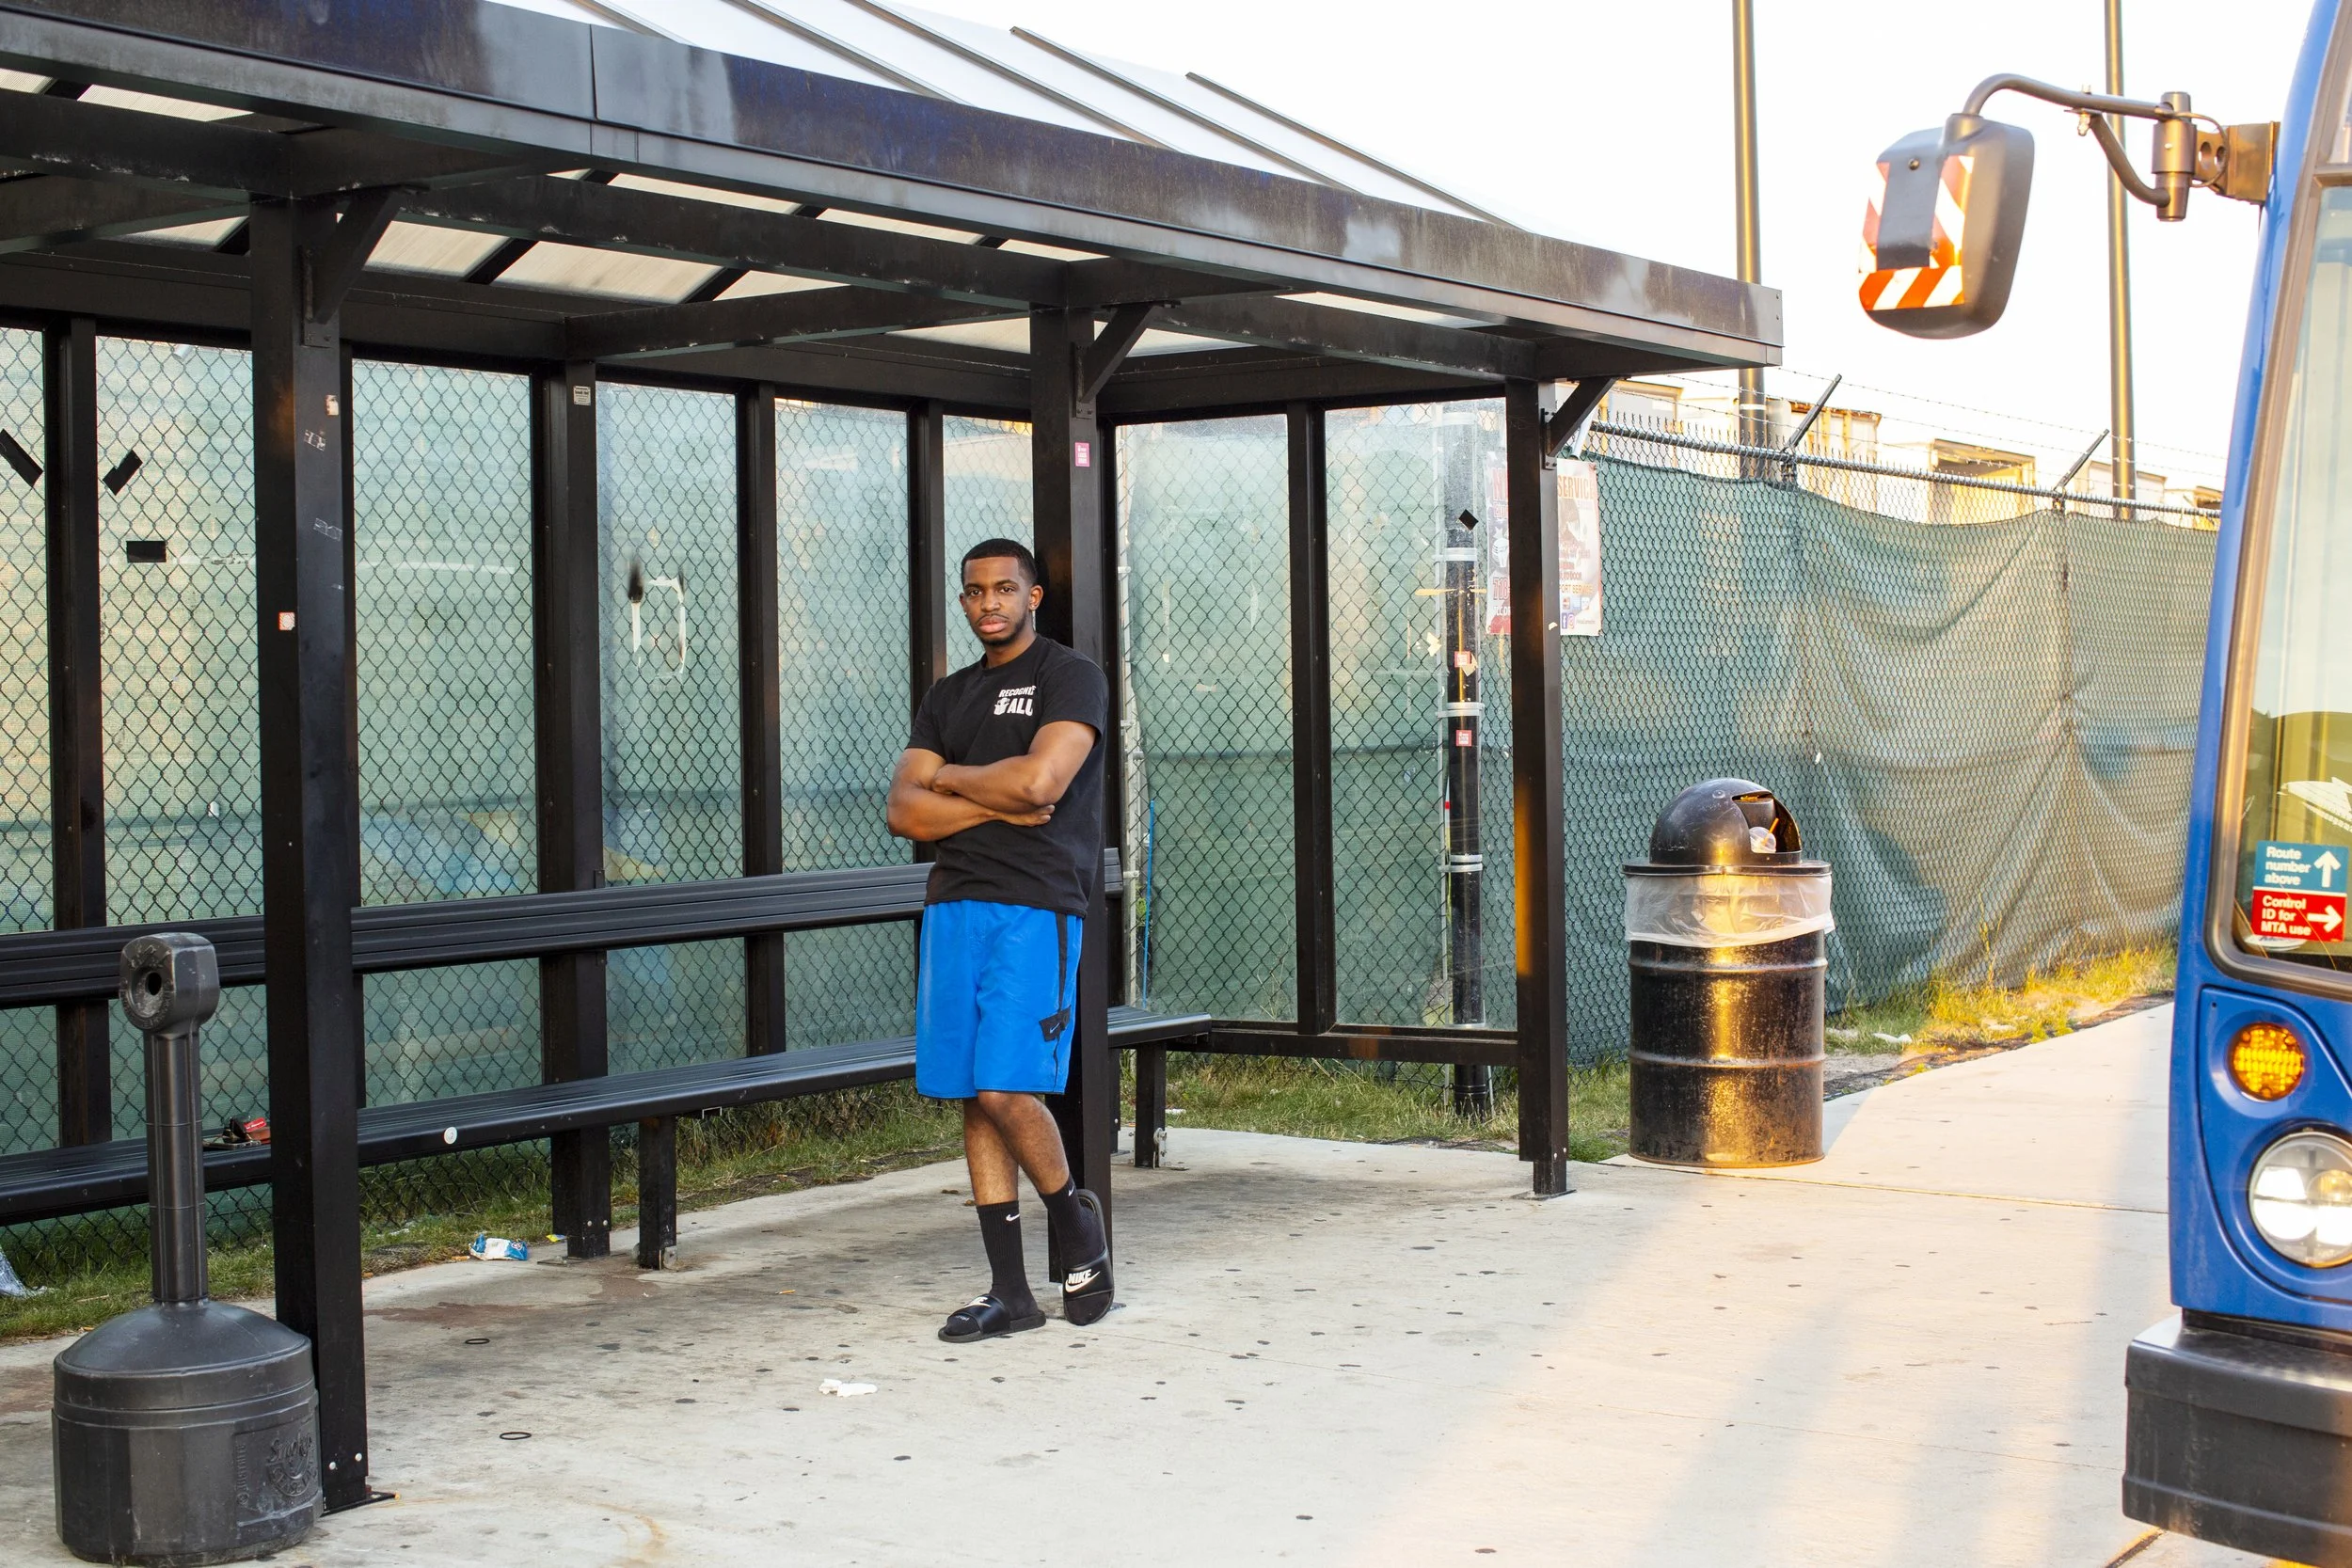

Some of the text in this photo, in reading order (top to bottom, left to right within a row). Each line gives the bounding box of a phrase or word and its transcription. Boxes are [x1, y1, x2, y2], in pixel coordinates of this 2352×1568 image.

[2266, 847, 2302, 860] Route
[2265, 862, 2312, 873] number
[2265, 873, 2301, 885] above
[2263, 895, 2307, 909] Control
[2262, 909, 2296, 922] ID for
[2261, 922, 2312, 936] MTA use
[1068, 1269, 1092, 1284] NIKE
